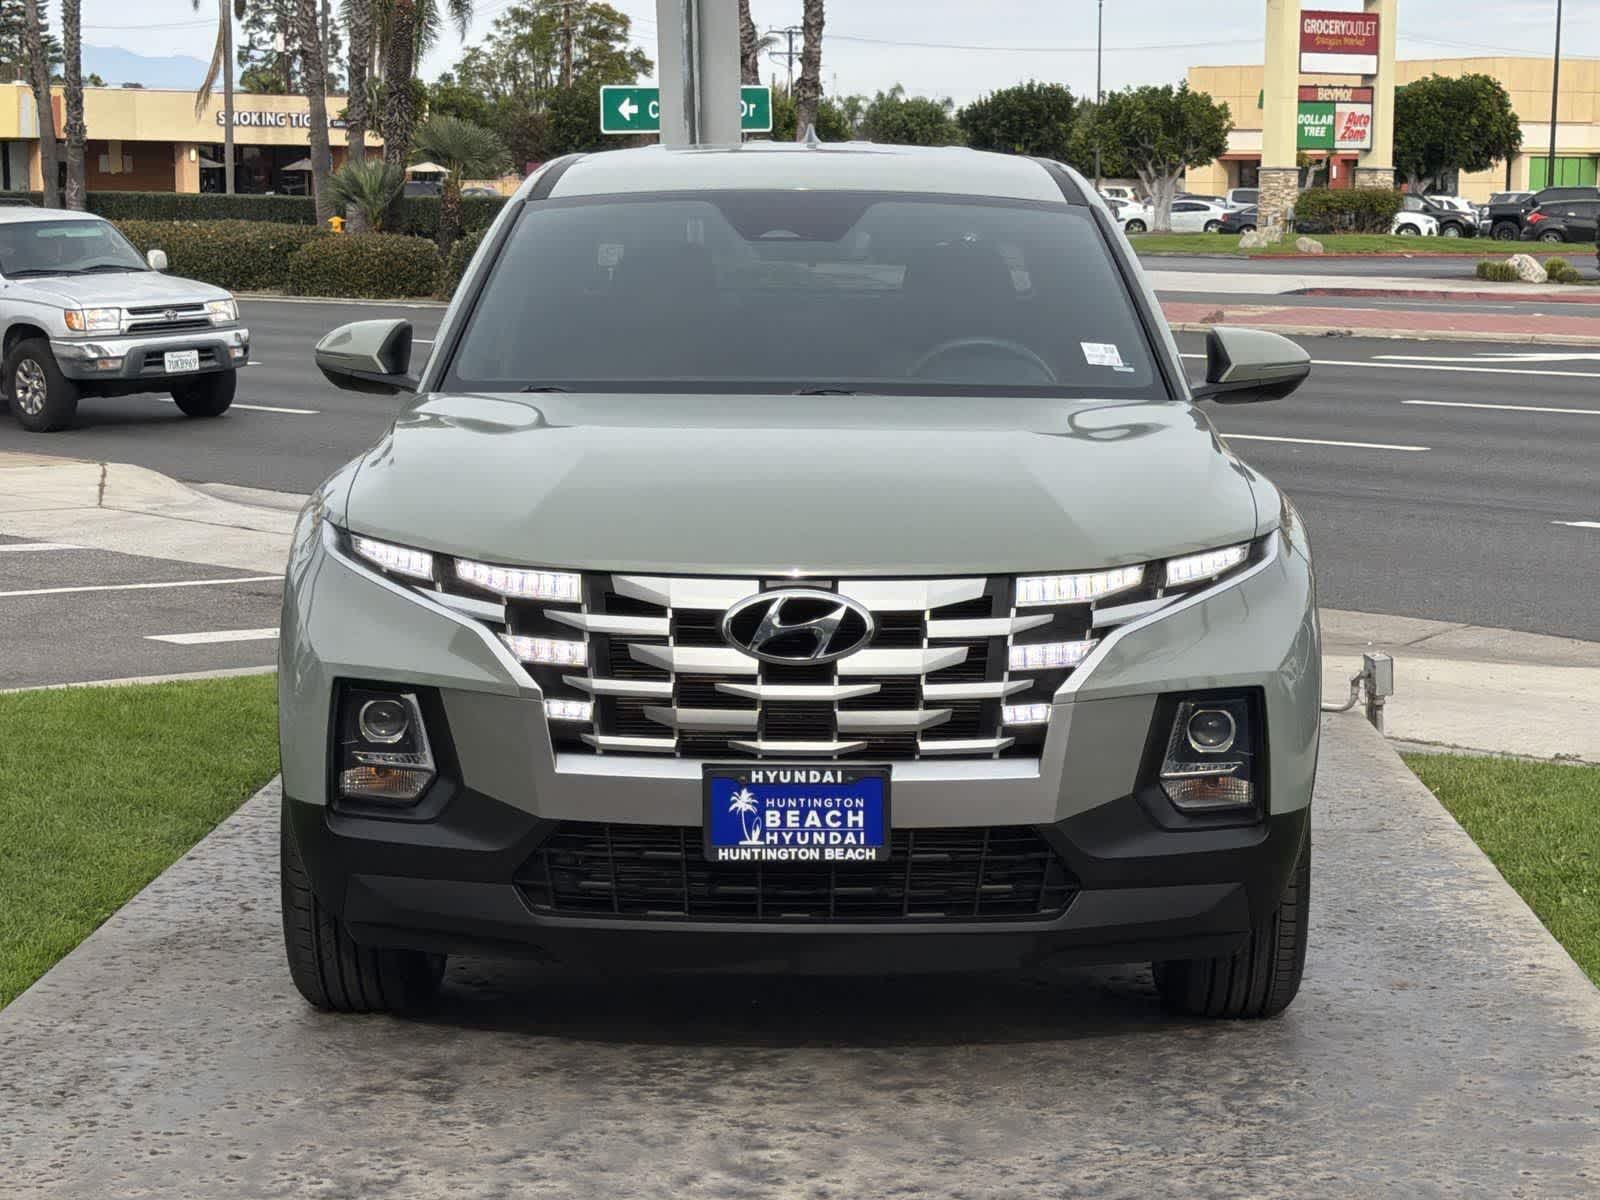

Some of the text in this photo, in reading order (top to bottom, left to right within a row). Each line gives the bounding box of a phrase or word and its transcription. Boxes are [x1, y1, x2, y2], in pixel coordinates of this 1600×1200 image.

[1298, 114, 1334, 125] DOLLAR
[1345, 111, 1370, 126] Auto
[1304, 126, 1326, 137] TREE
[1340, 126, 1366, 141] Zone
[751, 770, 842, 783] HYUNDAI
[766, 798, 864, 808] HUNTINGTON
[765, 810, 864, 828] BEACH
[766, 832, 865, 845] HYUNDAI
[718, 848, 876, 860] HUNTINGTON BEACH
